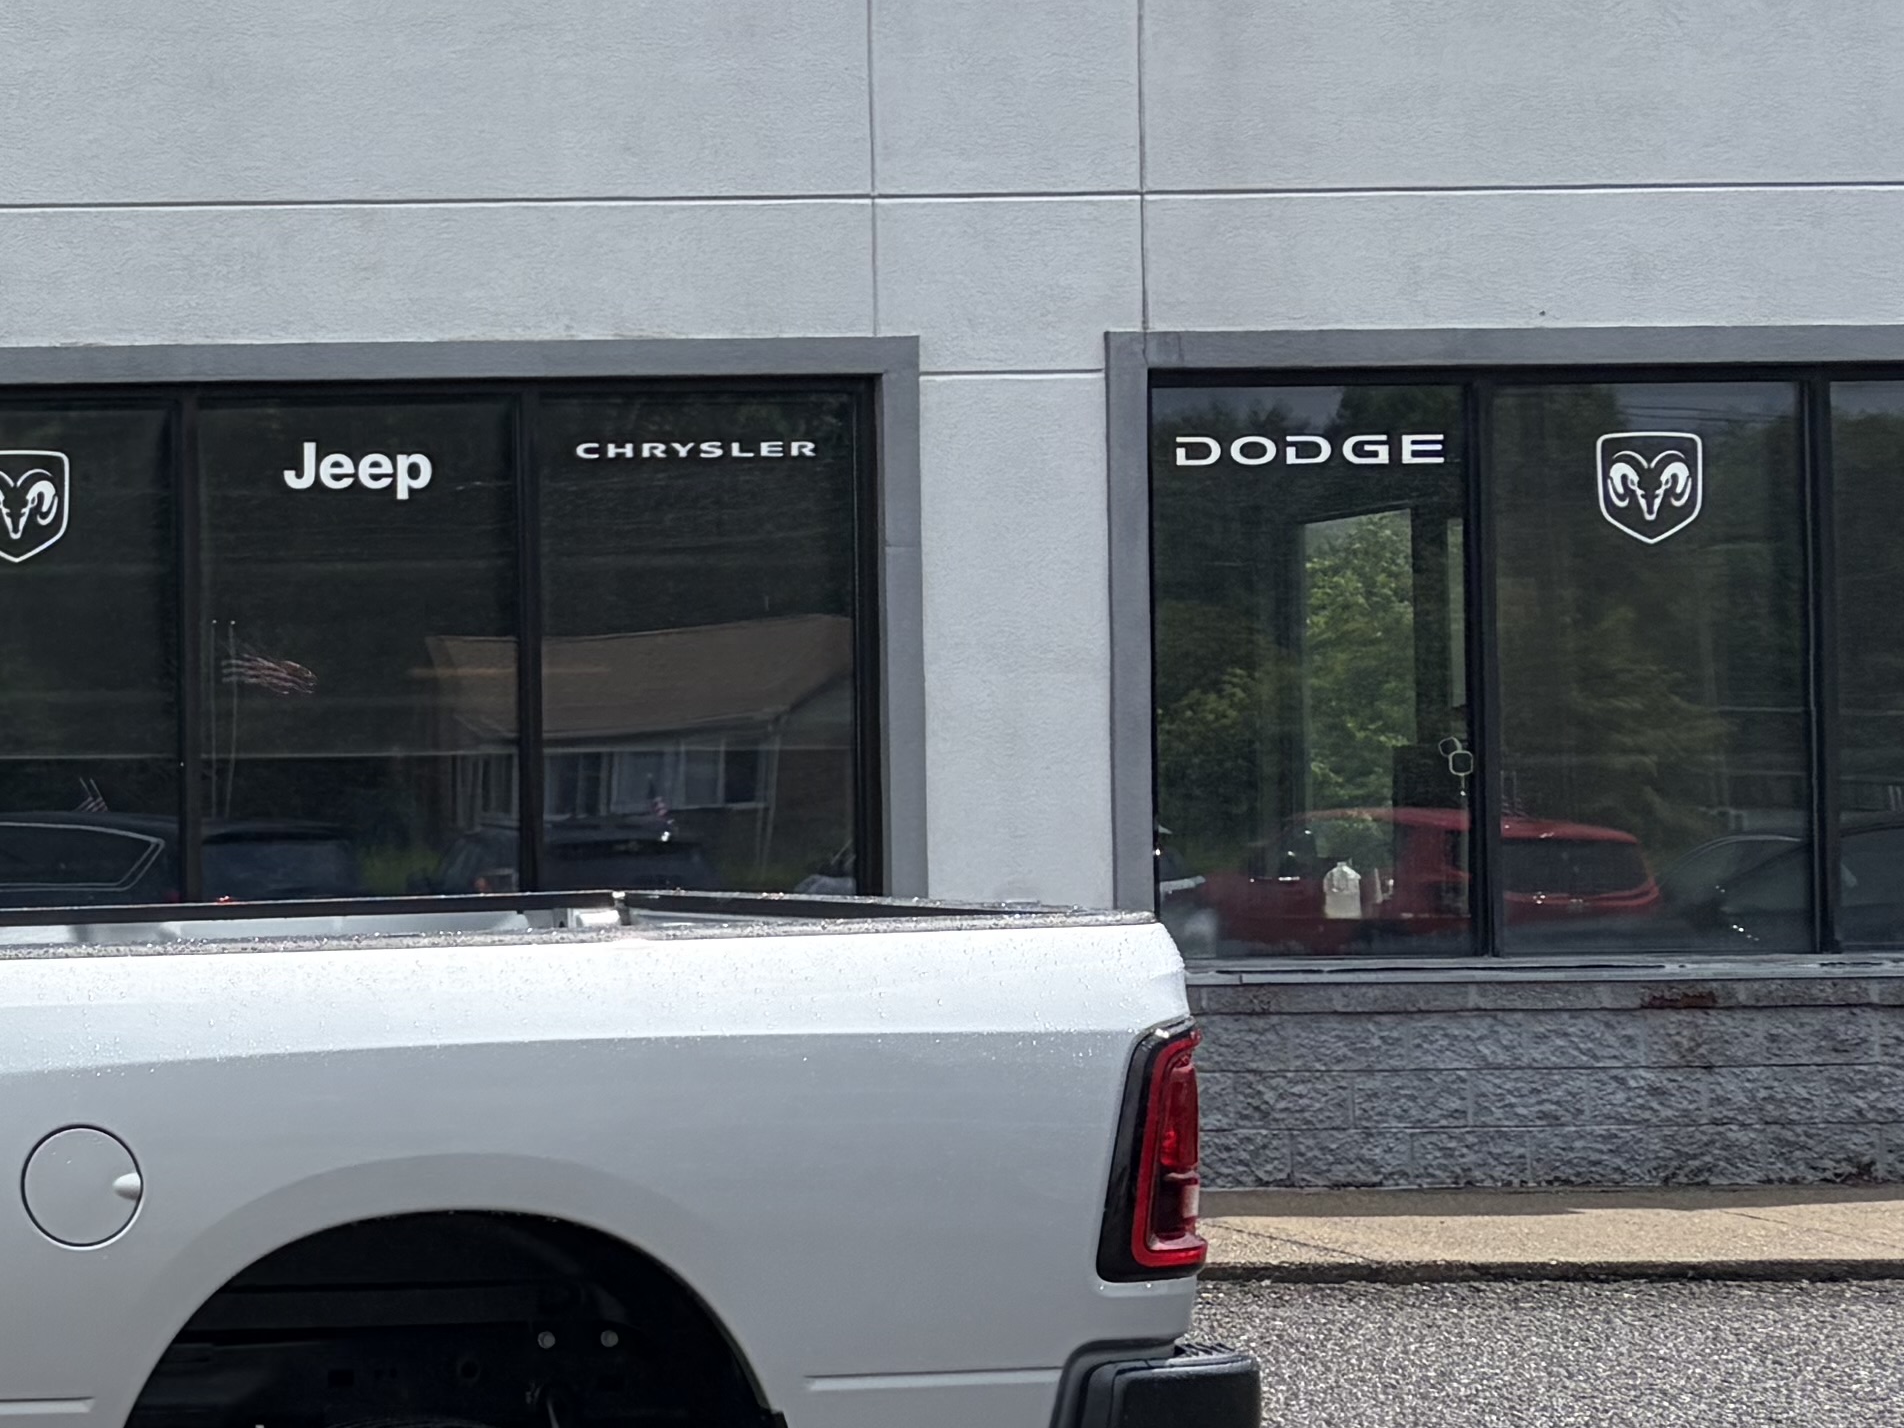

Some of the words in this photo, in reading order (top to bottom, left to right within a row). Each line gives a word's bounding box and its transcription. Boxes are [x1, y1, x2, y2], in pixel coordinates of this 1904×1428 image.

[575, 440, 817, 460] CHRYSLER
[1175, 434, 1446, 467] DODGE
[283, 441, 433, 500] Jeep
